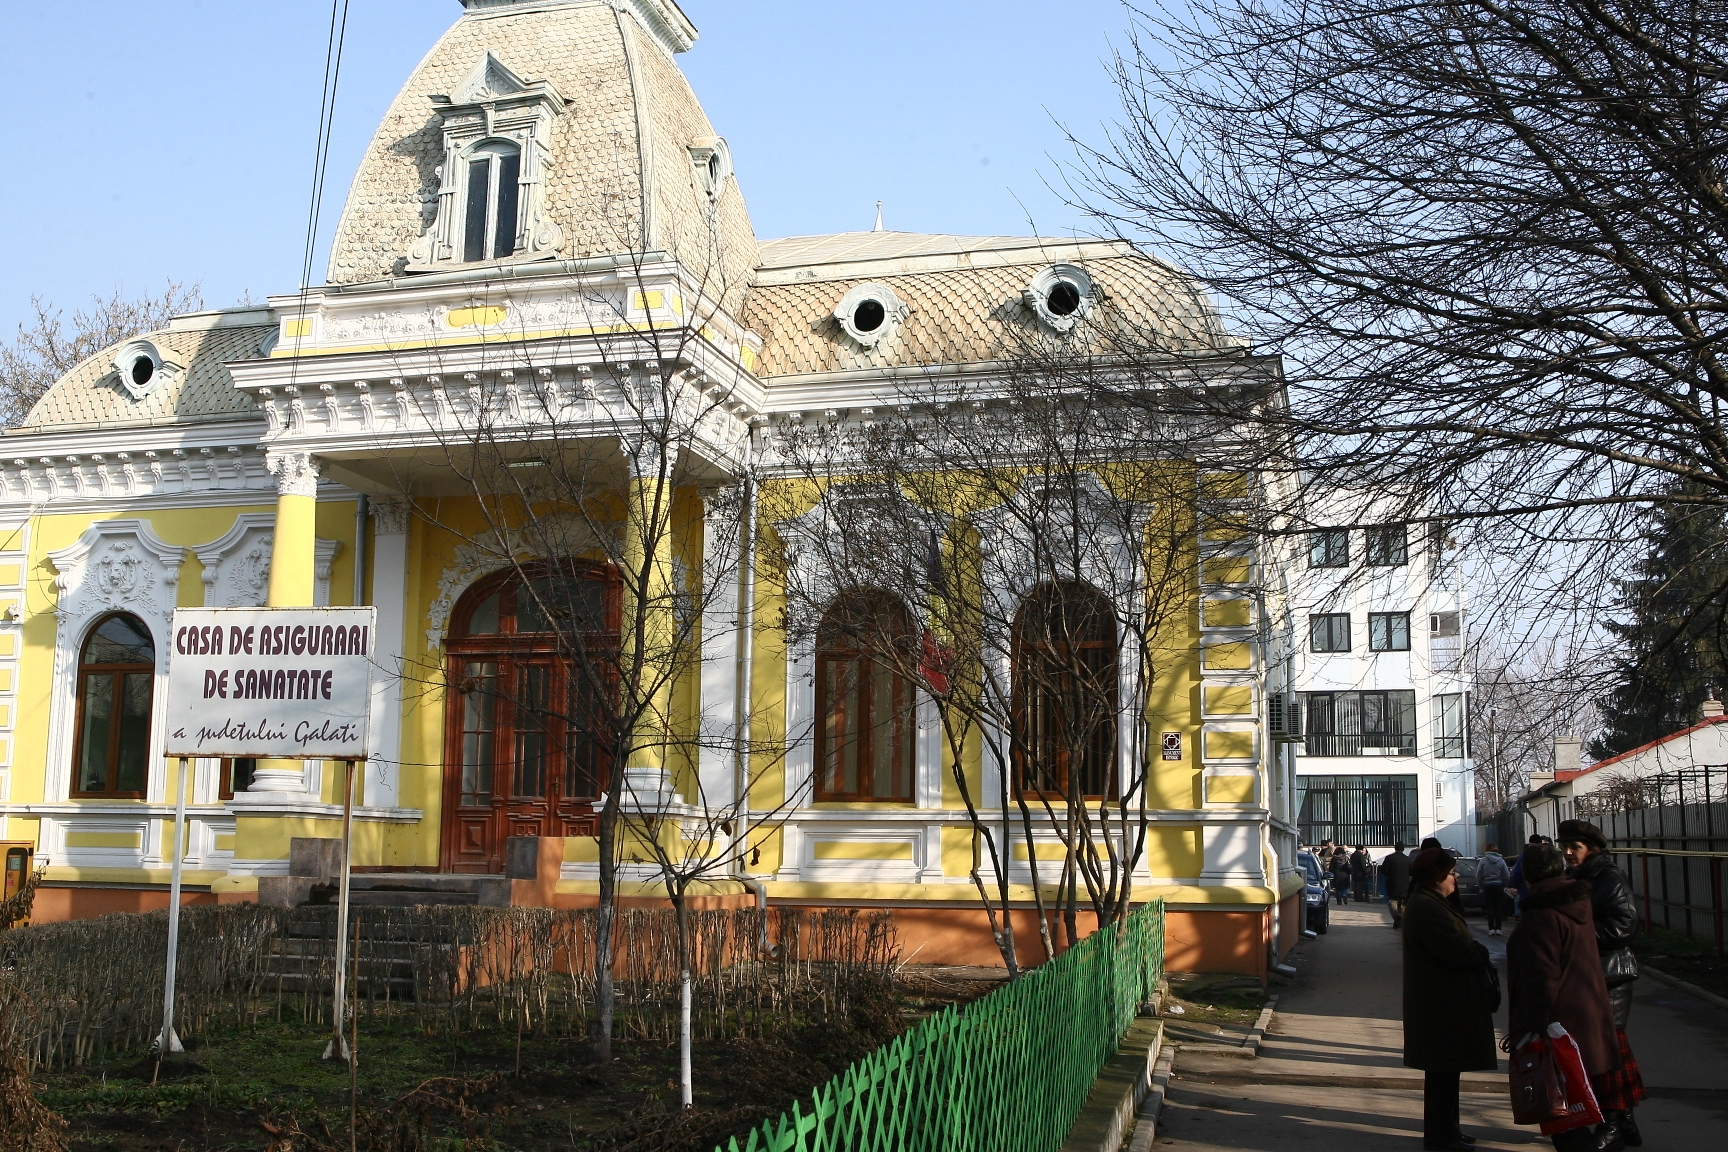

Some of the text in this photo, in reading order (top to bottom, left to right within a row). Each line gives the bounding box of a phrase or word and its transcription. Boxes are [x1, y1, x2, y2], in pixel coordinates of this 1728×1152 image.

[176, 624, 369, 656] CASA DE ASIGURARI
[203, 669, 333, 700] DE SANATATE
[172, 717, 360, 749] a judetului Galati
